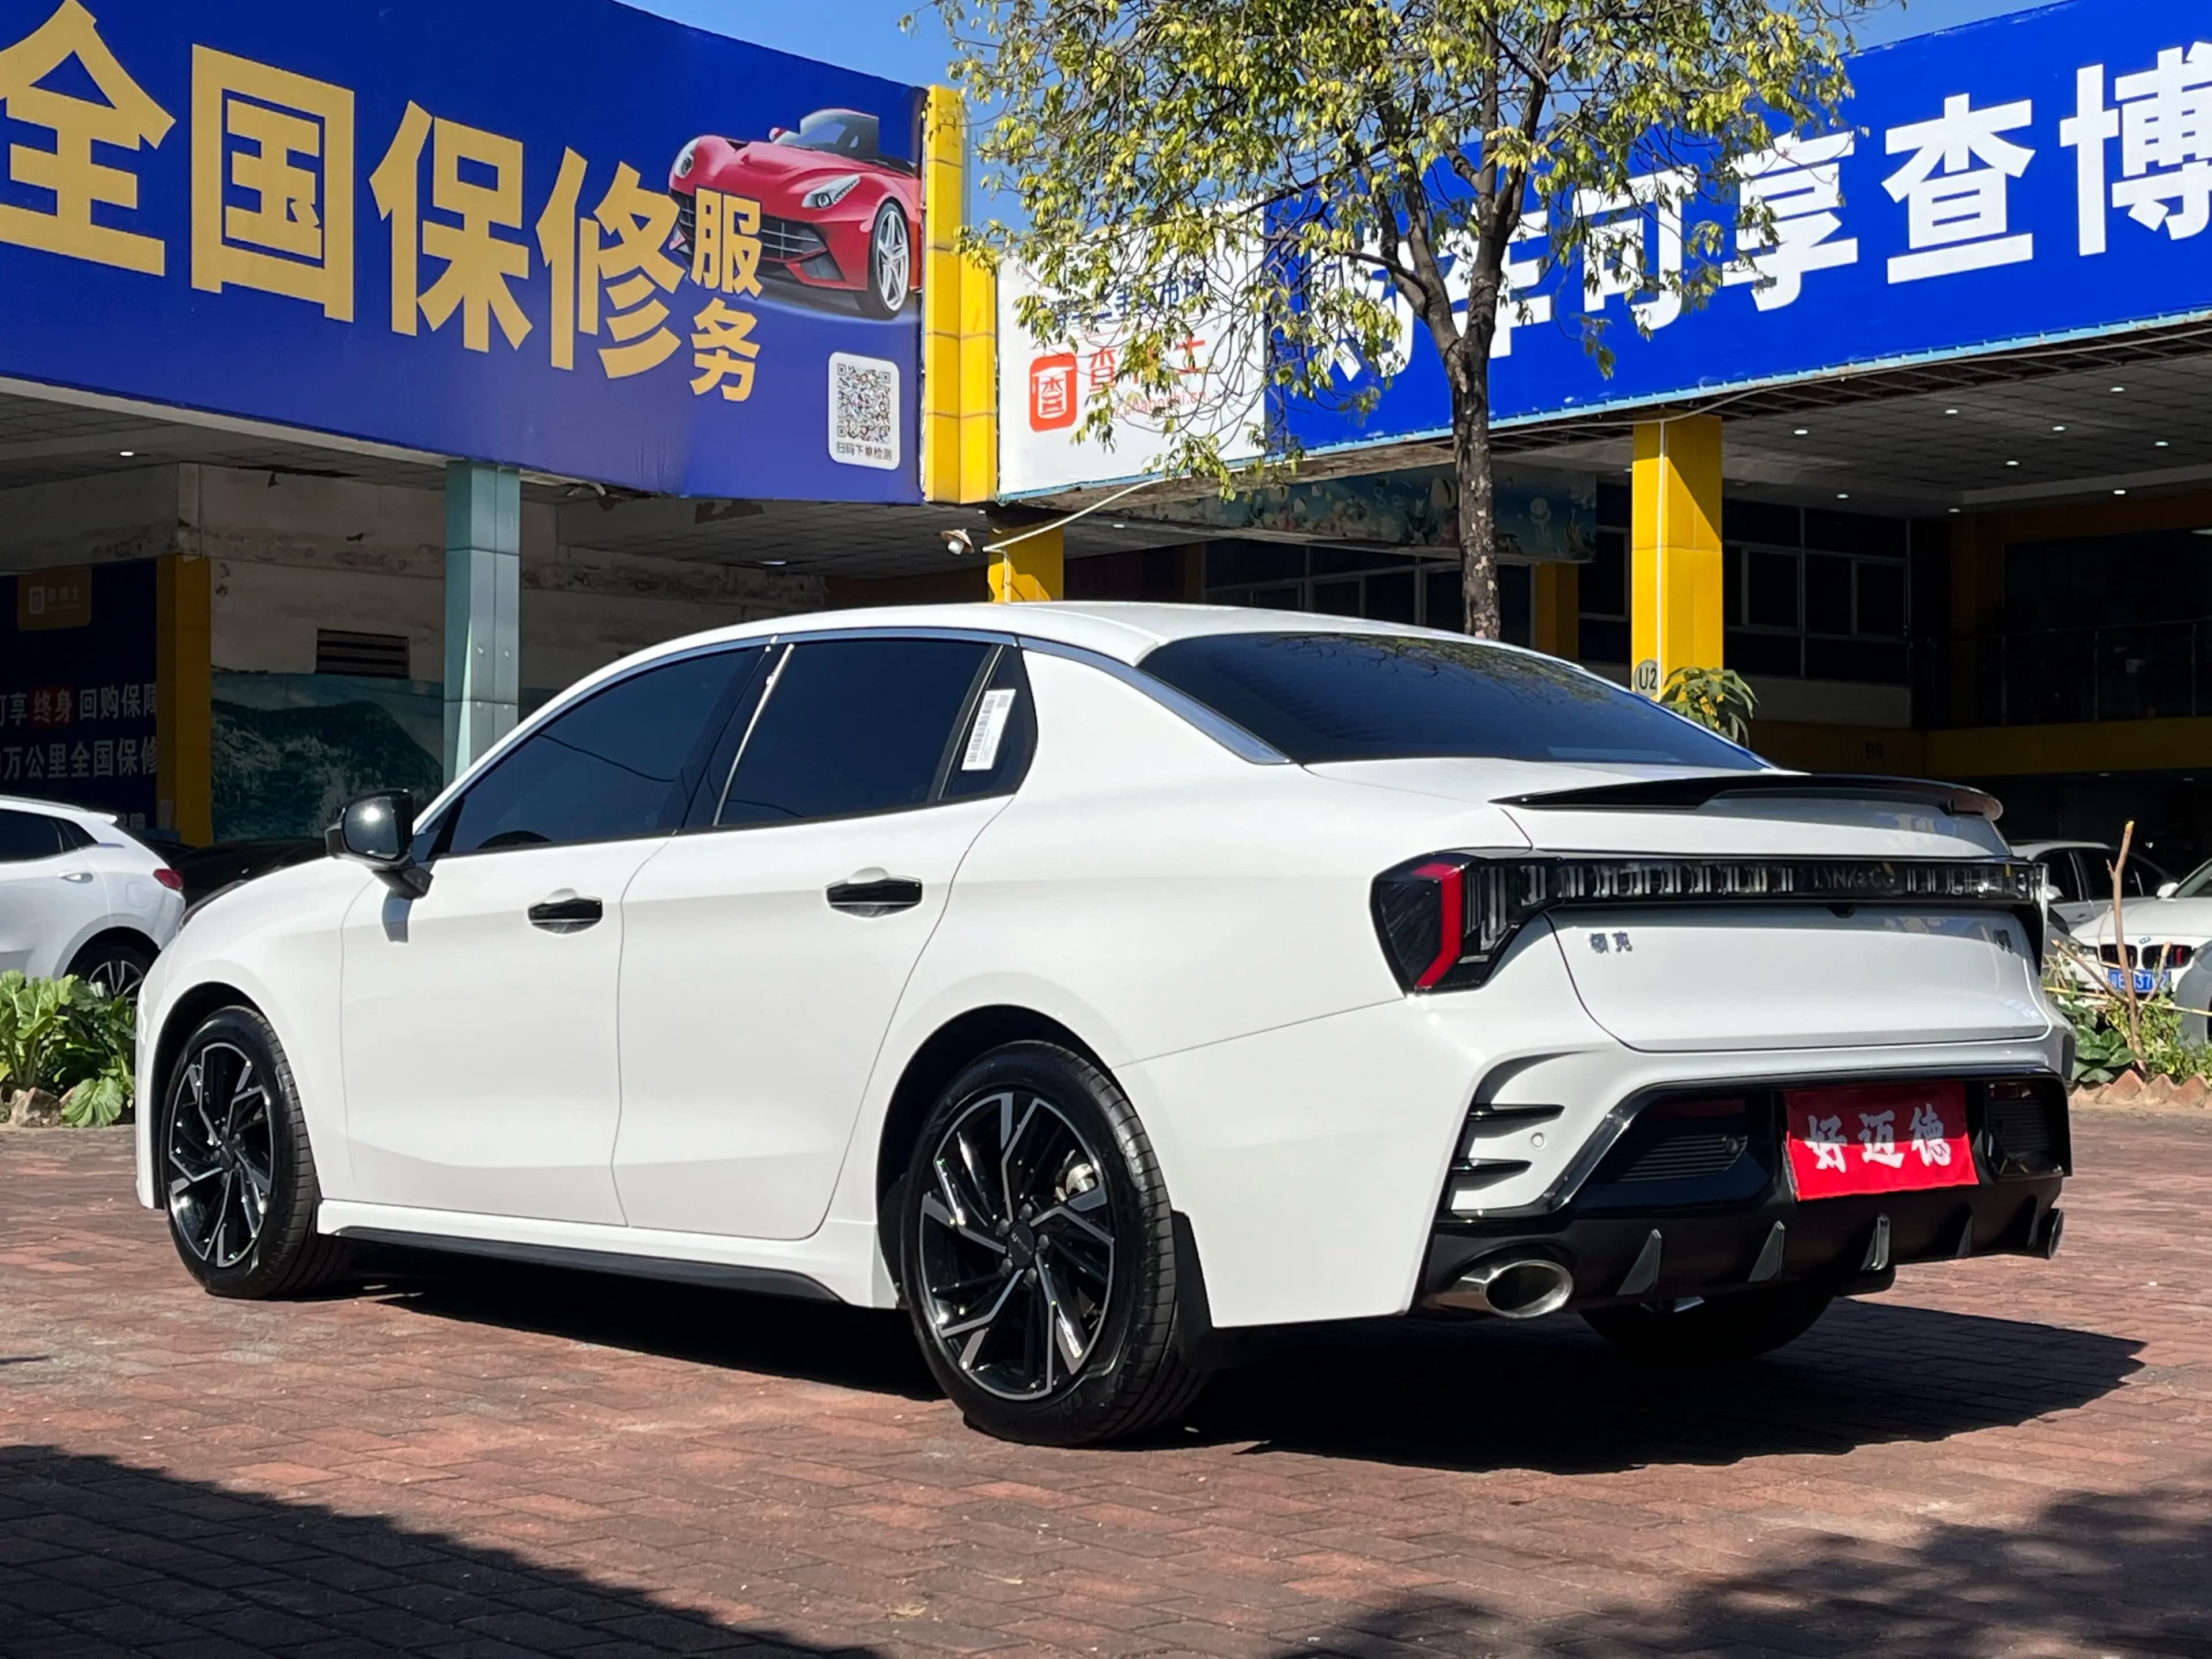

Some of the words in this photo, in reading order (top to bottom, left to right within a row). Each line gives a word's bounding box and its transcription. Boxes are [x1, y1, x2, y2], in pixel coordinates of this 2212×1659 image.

[0, 0, 687, 379] 全国保修
[690, 188, 762, 402] 服务
[1638, 667, 1657, 690] U2
[0, 736, 157, 780] 万公里全国保修
